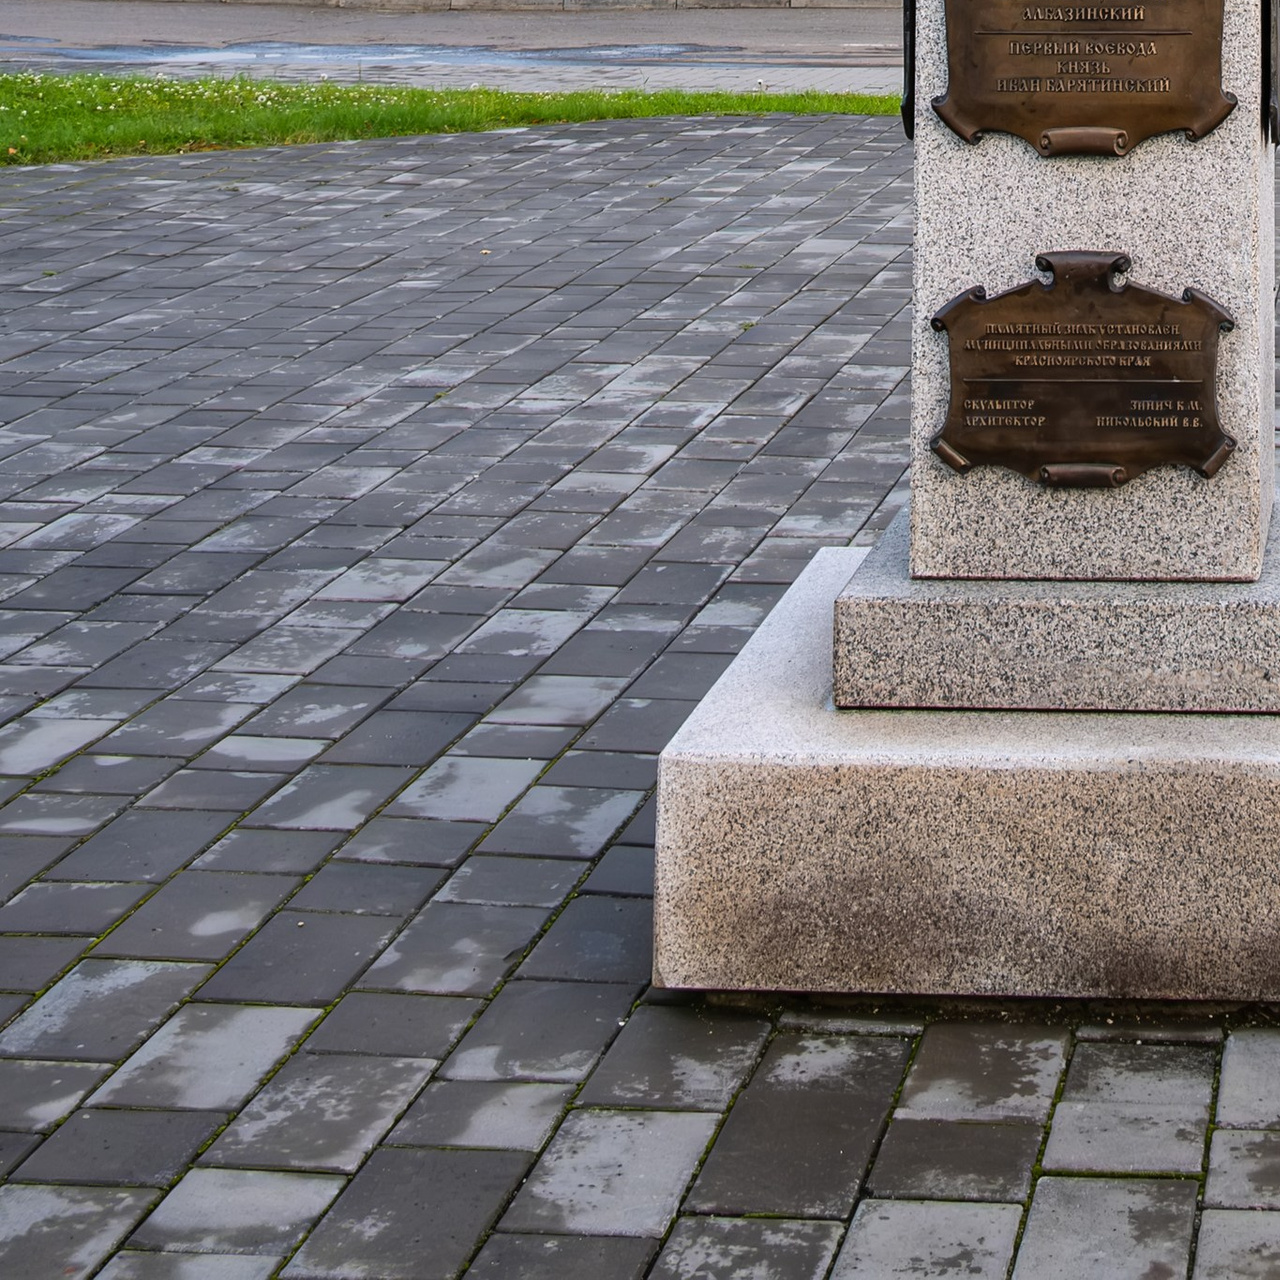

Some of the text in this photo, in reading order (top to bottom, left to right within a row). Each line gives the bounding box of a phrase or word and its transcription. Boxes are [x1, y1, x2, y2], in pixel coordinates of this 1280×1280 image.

[1022, 5, 1146, 22] АЛБАЗИНСКИЙ
[1008, 40, 1158, 57] ПЕРВЫЙ ВОЕВОДА
[1056, 60, 1111, 75] КНЯЗЬ
[996, 76, 1171, 93] ИВАН БАРЯТИНСКИЙ
[985, 322, 1180, 336] ПАМЯТНЫЙ ЗНАК УСТАНОВЛЕН
[964, 340, 1202, 351] МУНИЦИПАЛЬНЫМИ ОБРАЗОВАНИЯМИ
[1015, 355, 1151, 366] КРАСНОЯРСКОГО КРАЯ
[963, 399, 1035, 410] СКУЛЬПТОР
[964, 416, 1046, 427] АРХИТЕКТОР
[1096, 415, 1178, 427] НИКОЛЬСКИЙ
